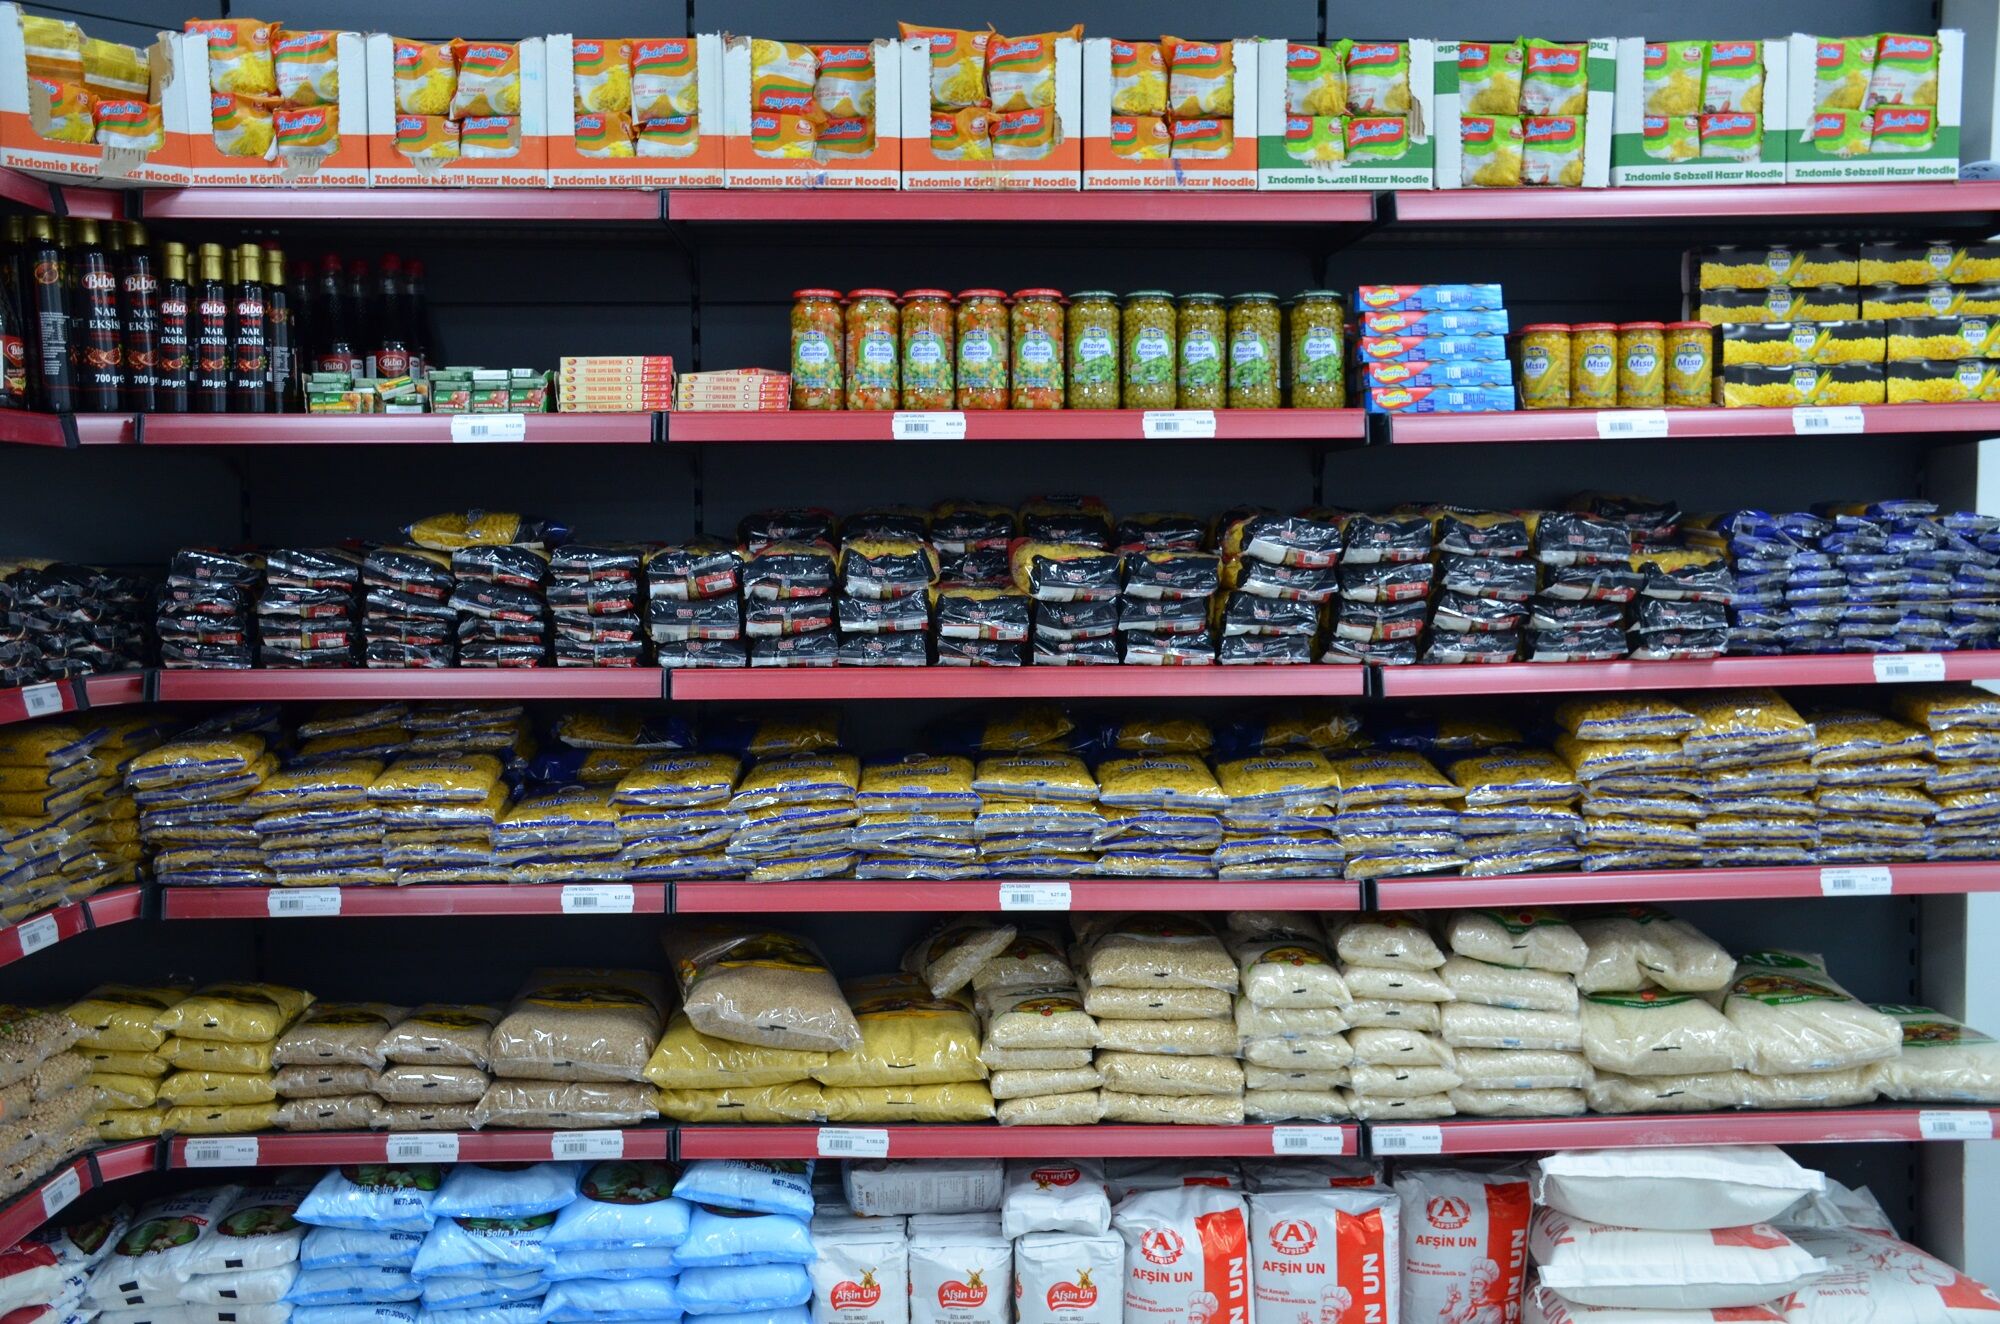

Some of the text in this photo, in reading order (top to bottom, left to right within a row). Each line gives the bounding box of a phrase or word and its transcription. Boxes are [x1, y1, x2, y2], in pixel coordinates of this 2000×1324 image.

[7, 155, 189, 184] Indomie Köri Noodle
[1624, 168, 1784, 182] Indomie Sebzeli Hazır Noodle
[1795, 165, 1956, 178] Indomie Sebzeli Hazır Noodle
[193, 175, 247, 184] Indomie
[297, 176, 318, 184] azır
[321, 175, 366, 184] Noodle
[375, 175, 428, 185] Indomie
[467, 175, 499, 184] Hazır
[501, 175, 546, 185] Noodle
[553, 174, 723, 185] Indomie Körili Hazır Noodle
[730, 176, 784, 186] Indomie
[854, 176, 898, 186] Noodle
[909, 177, 960, 187] Indomie
[1032, 177, 1077, 187] Noodle
[1089, 176, 1141, 186] Indomie
[1143, 176, 1176, 186] Körili
[1212, 176, 1255, 186] Noodle
[1267, 174, 1315, 184] Indomie
[1359, 174, 1388, 184] Hazır
[1390, 174, 1430, 184] Noodle
[94, 306, 117, 317] NAR
[161, 301, 187, 315] Biba
[201, 301, 227, 315] Biba
[238, 301, 264, 315] Biba
[128, 320, 158, 332] EKŞİS
[164, 326, 183, 336] NAR
[204, 326, 224, 336] NAR
[240, 326, 260, 336] NAR
[160, 336, 187, 347] EKŞİSİ
[201, 336, 228, 348] EKŞİSİ
[238, 336, 265, 348] EKŞİSİ
[383, 358, 403, 368] Biba
[95, 374, 110, 384] 700
[134, 375, 149, 385] 700
[651, 760, 711, 772] ankara
[1119, 760, 1191, 772] ankara
[1243, 759, 1316, 771] ankara
[750, 1161, 772, 1173] Sofra
[1440, 1201, 1458, 1217] A
[1434, 1218, 1461, 1230] AFŞİN
[486, 1228, 510, 1238] Sofra
[1283, 1224, 1304, 1241] A
[1151, 1233, 1171, 1250] A
[1415, 1233, 1477, 1249] AFŞİN UN
[1279, 1244, 1307, 1255] AFŞİN
[1147, 1253, 1174, 1265] AFŞİN
[1262, 1261, 1326, 1276] AFŞİN UN
[1132, 1268, 1193, 1285] AFŞİN UN
[835, 1288, 878, 1302] Afşin Un
[943, 1287, 983, 1301] Afşin Un
[1051, 1288, 1094, 1302] Afşin Un
